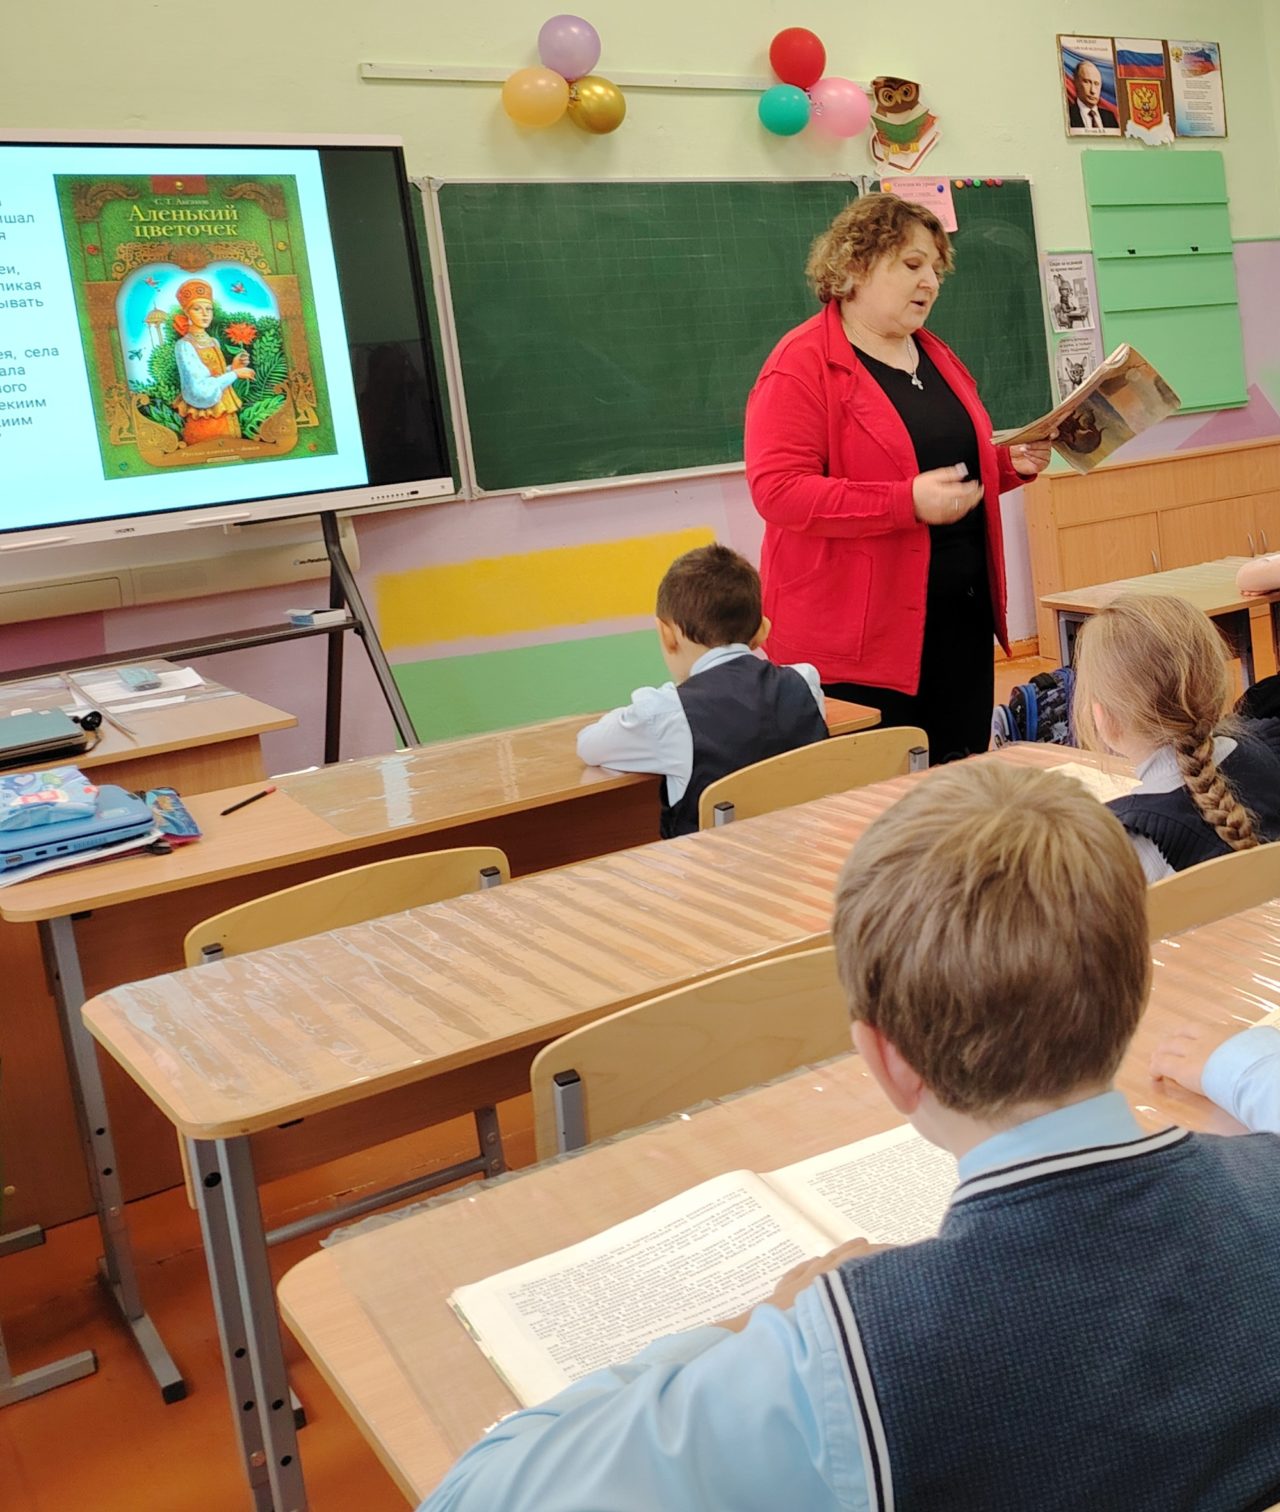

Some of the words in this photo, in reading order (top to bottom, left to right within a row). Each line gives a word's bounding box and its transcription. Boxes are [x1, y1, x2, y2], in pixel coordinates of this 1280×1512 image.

[0, 214, 35, 224] шал
[128, 204, 239, 222] Аленький
[134, 224, 238, 240] цветочек
[24, 347, 60, 358] села
